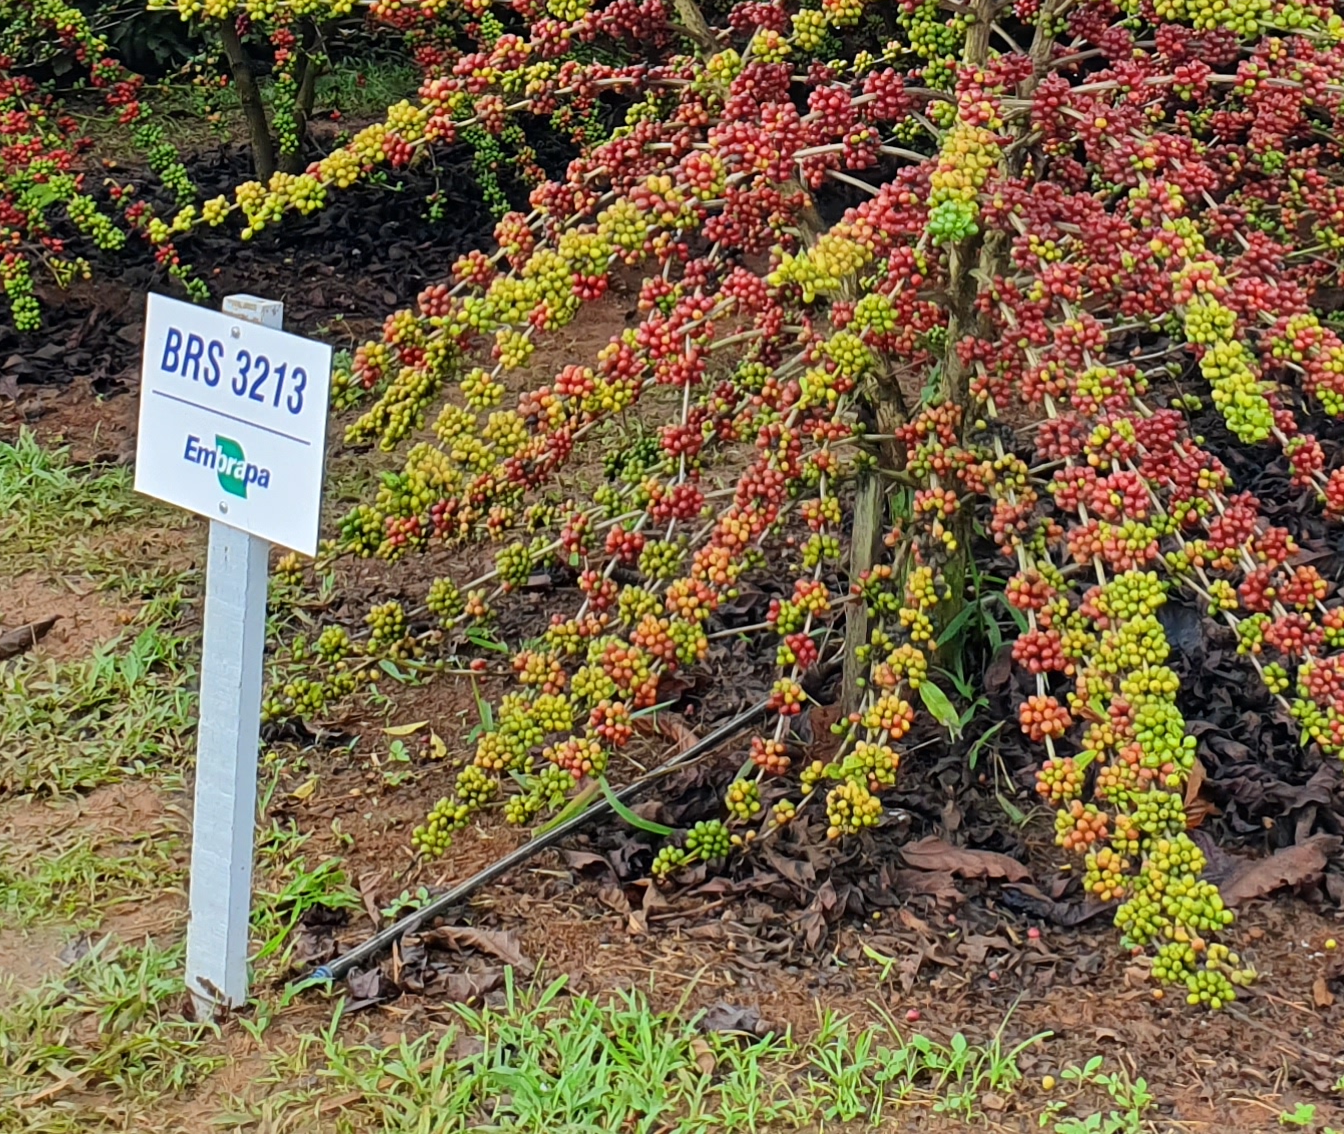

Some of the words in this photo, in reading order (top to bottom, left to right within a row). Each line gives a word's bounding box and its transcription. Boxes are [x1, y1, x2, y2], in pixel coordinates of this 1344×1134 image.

[161, 326, 224, 388] BRS
[231, 349, 308, 415] 3213
[183, 434, 272, 489] Embrapa
